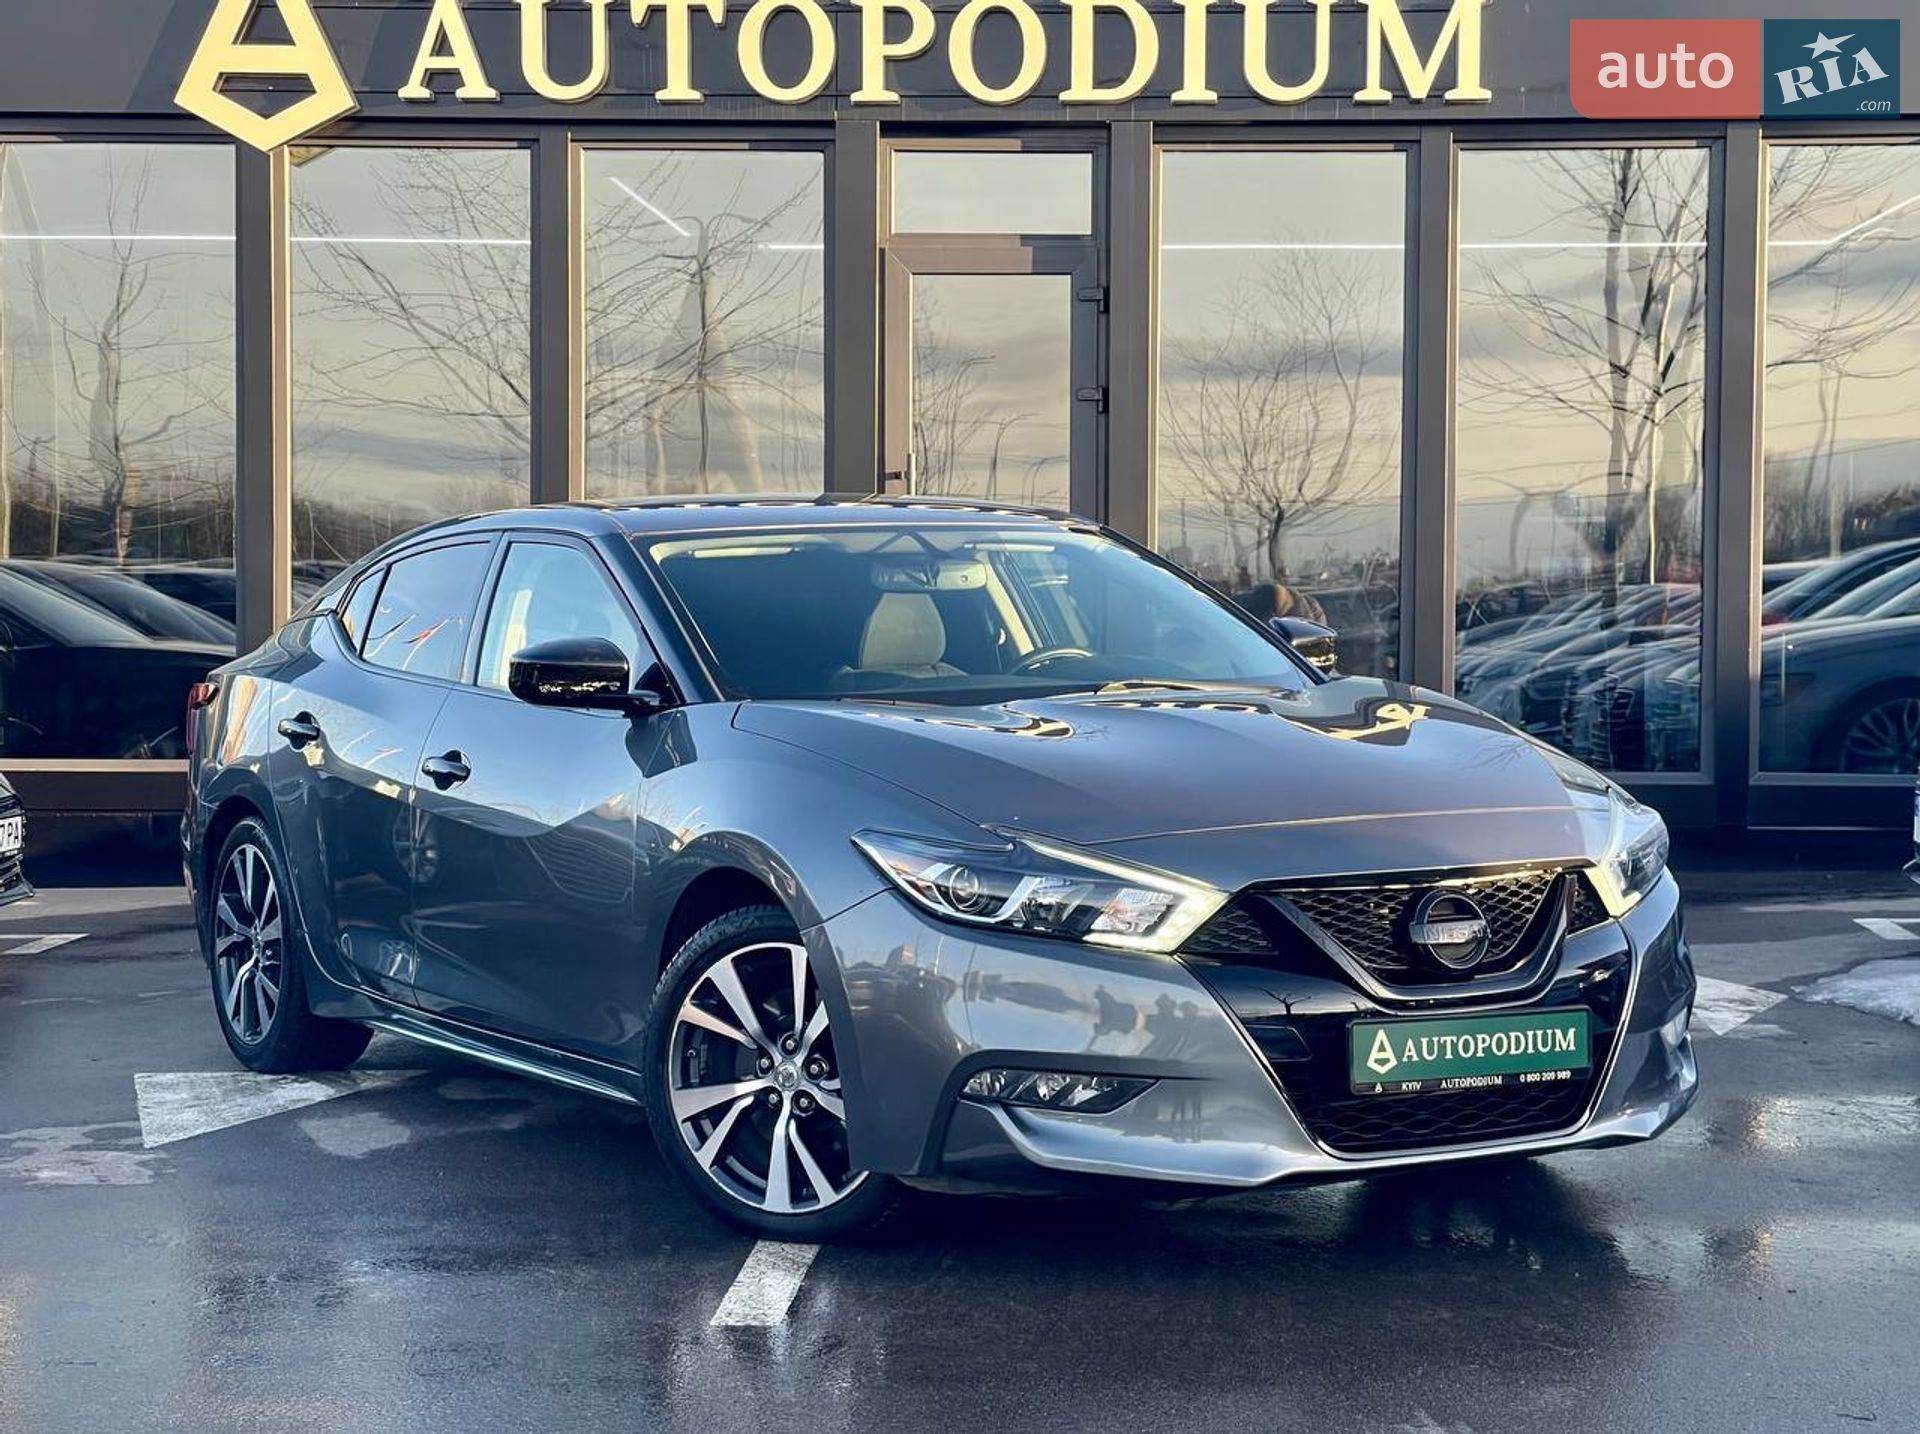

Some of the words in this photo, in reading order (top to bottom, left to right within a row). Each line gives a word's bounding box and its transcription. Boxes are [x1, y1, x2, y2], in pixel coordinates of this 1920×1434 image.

[398, 0, 1493, 104] AUTOPODIUM
[1402, 1028, 1576, 1062] AUTOPODIUM
[1401, 1081, 1421, 1091] KYIV
[1440, 1075, 1502, 1088] AUTOPODIUM
